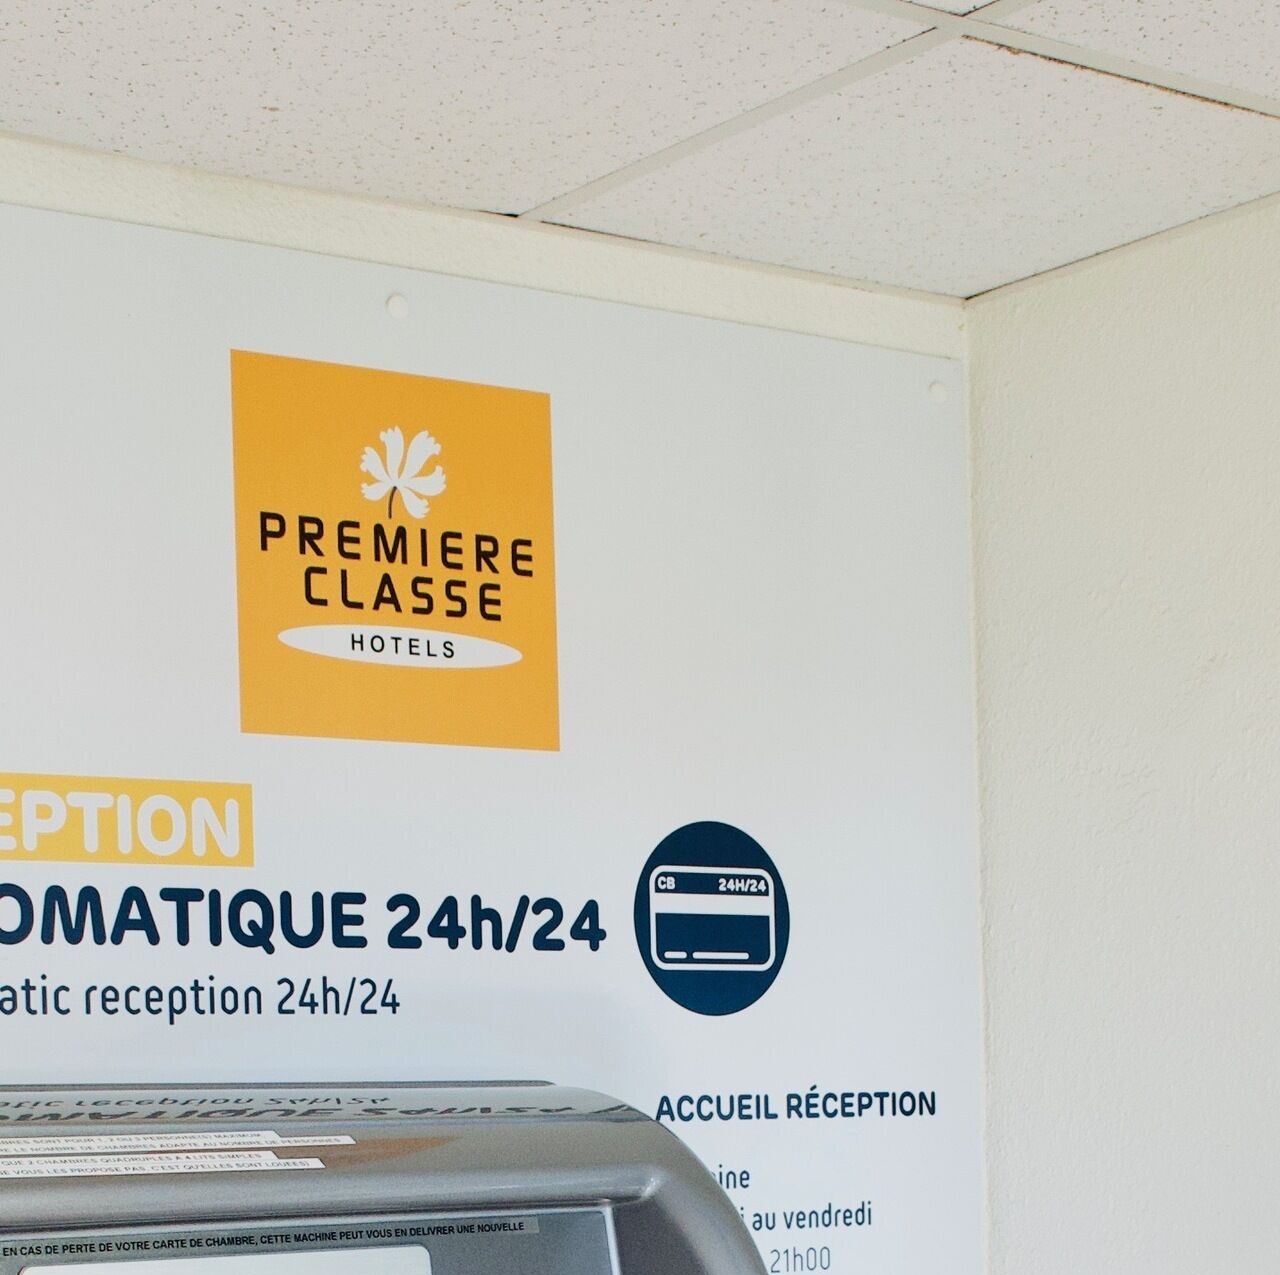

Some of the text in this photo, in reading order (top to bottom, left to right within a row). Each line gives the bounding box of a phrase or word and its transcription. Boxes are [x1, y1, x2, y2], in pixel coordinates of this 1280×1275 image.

[259, 511, 533, 577] PREMIERE
[304, 566, 502, 621] CLASSE
[350, 633, 455, 659] HOTELS
[657, 876, 767, 892] CB 24H/24
[385, 892, 607, 952] 24h/24
[82, 975, 264, 1026] reception
[275, 976, 402, 1016] 24h/24
[655, 1084, 937, 1121] ACCUEIL RÉCEPTION
[752, 1201, 872, 1231] au vendredi
[2, 1221, 525, 1257] EN CAS DE PERTE DE VOTRE CARTE DE CHAMBRE, CETTE MACHINE PEUT VOUS EN DELIVRER UNE NOUVELLE
[770, 1246, 831, 1273] 21h00
